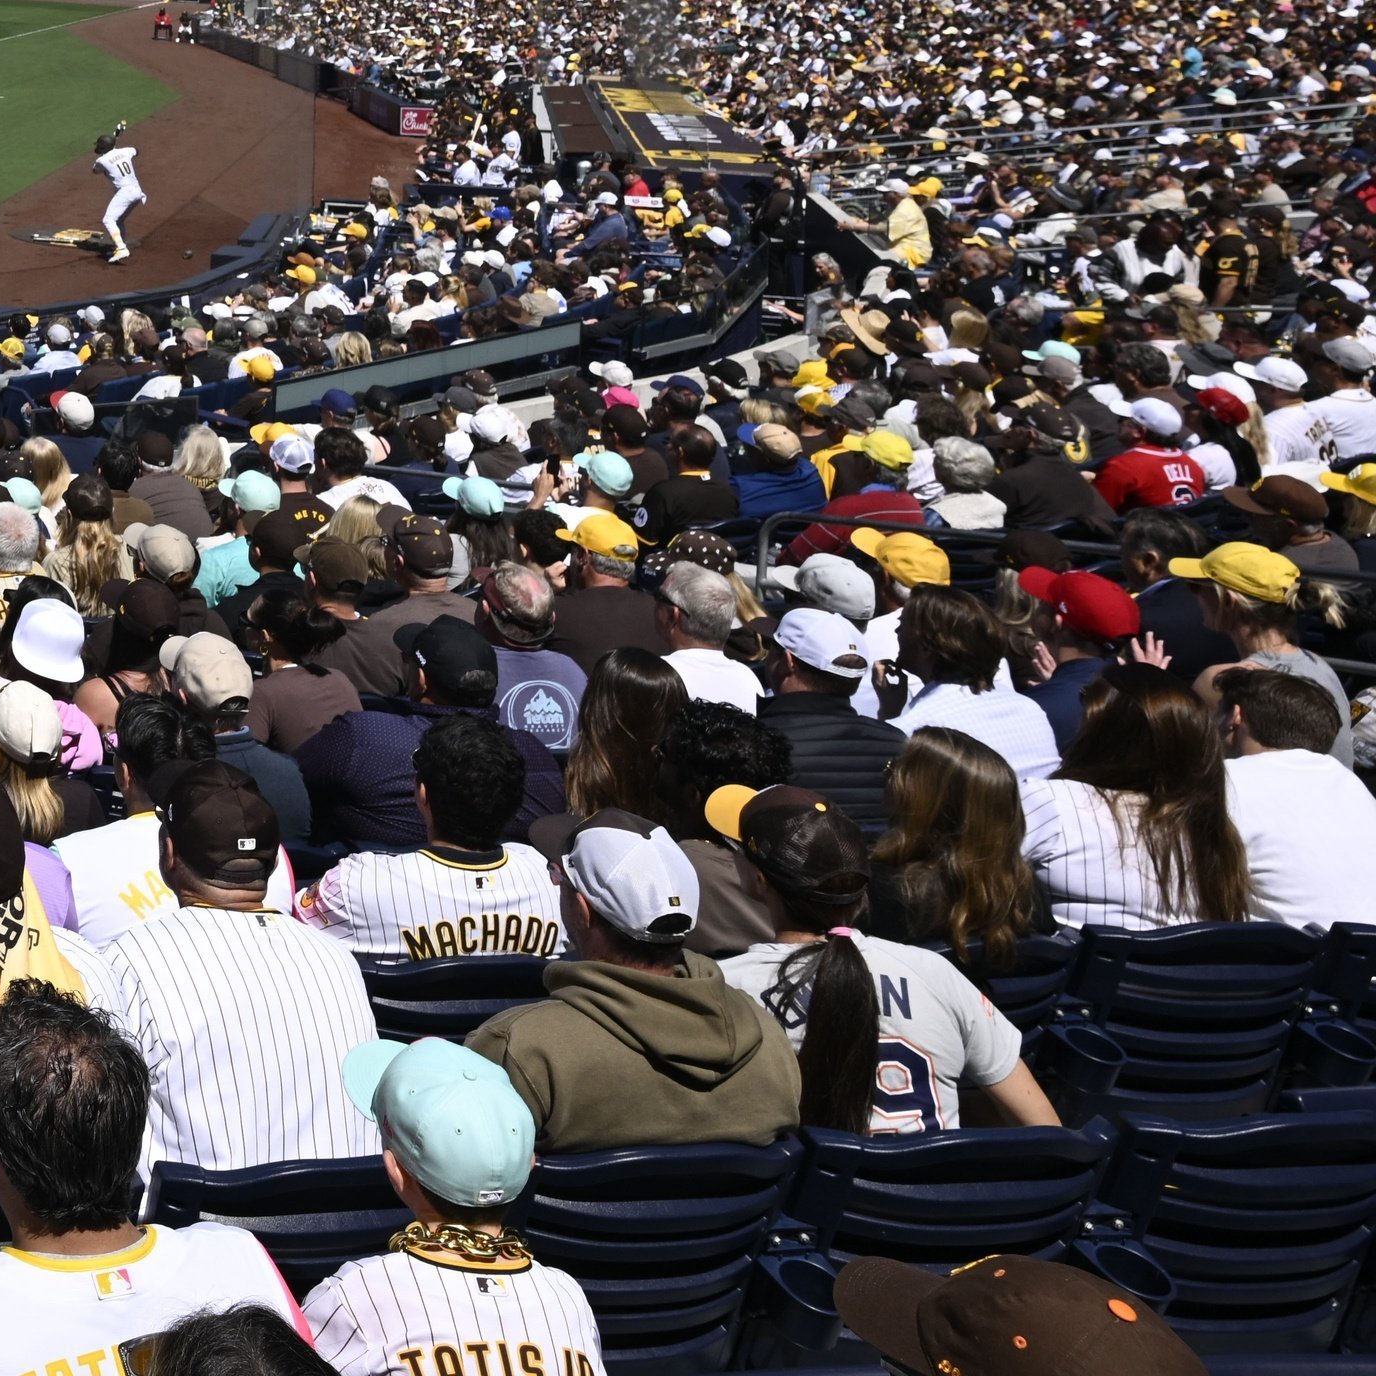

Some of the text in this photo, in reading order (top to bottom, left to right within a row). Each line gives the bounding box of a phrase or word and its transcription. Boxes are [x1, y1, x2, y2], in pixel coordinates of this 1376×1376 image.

[116, 160, 132, 177] 10
[1162, 463, 1194, 484] DELL
[401, 913, 560, 963] MACHADO
[397, 1339, 545, 1376] TATIS
